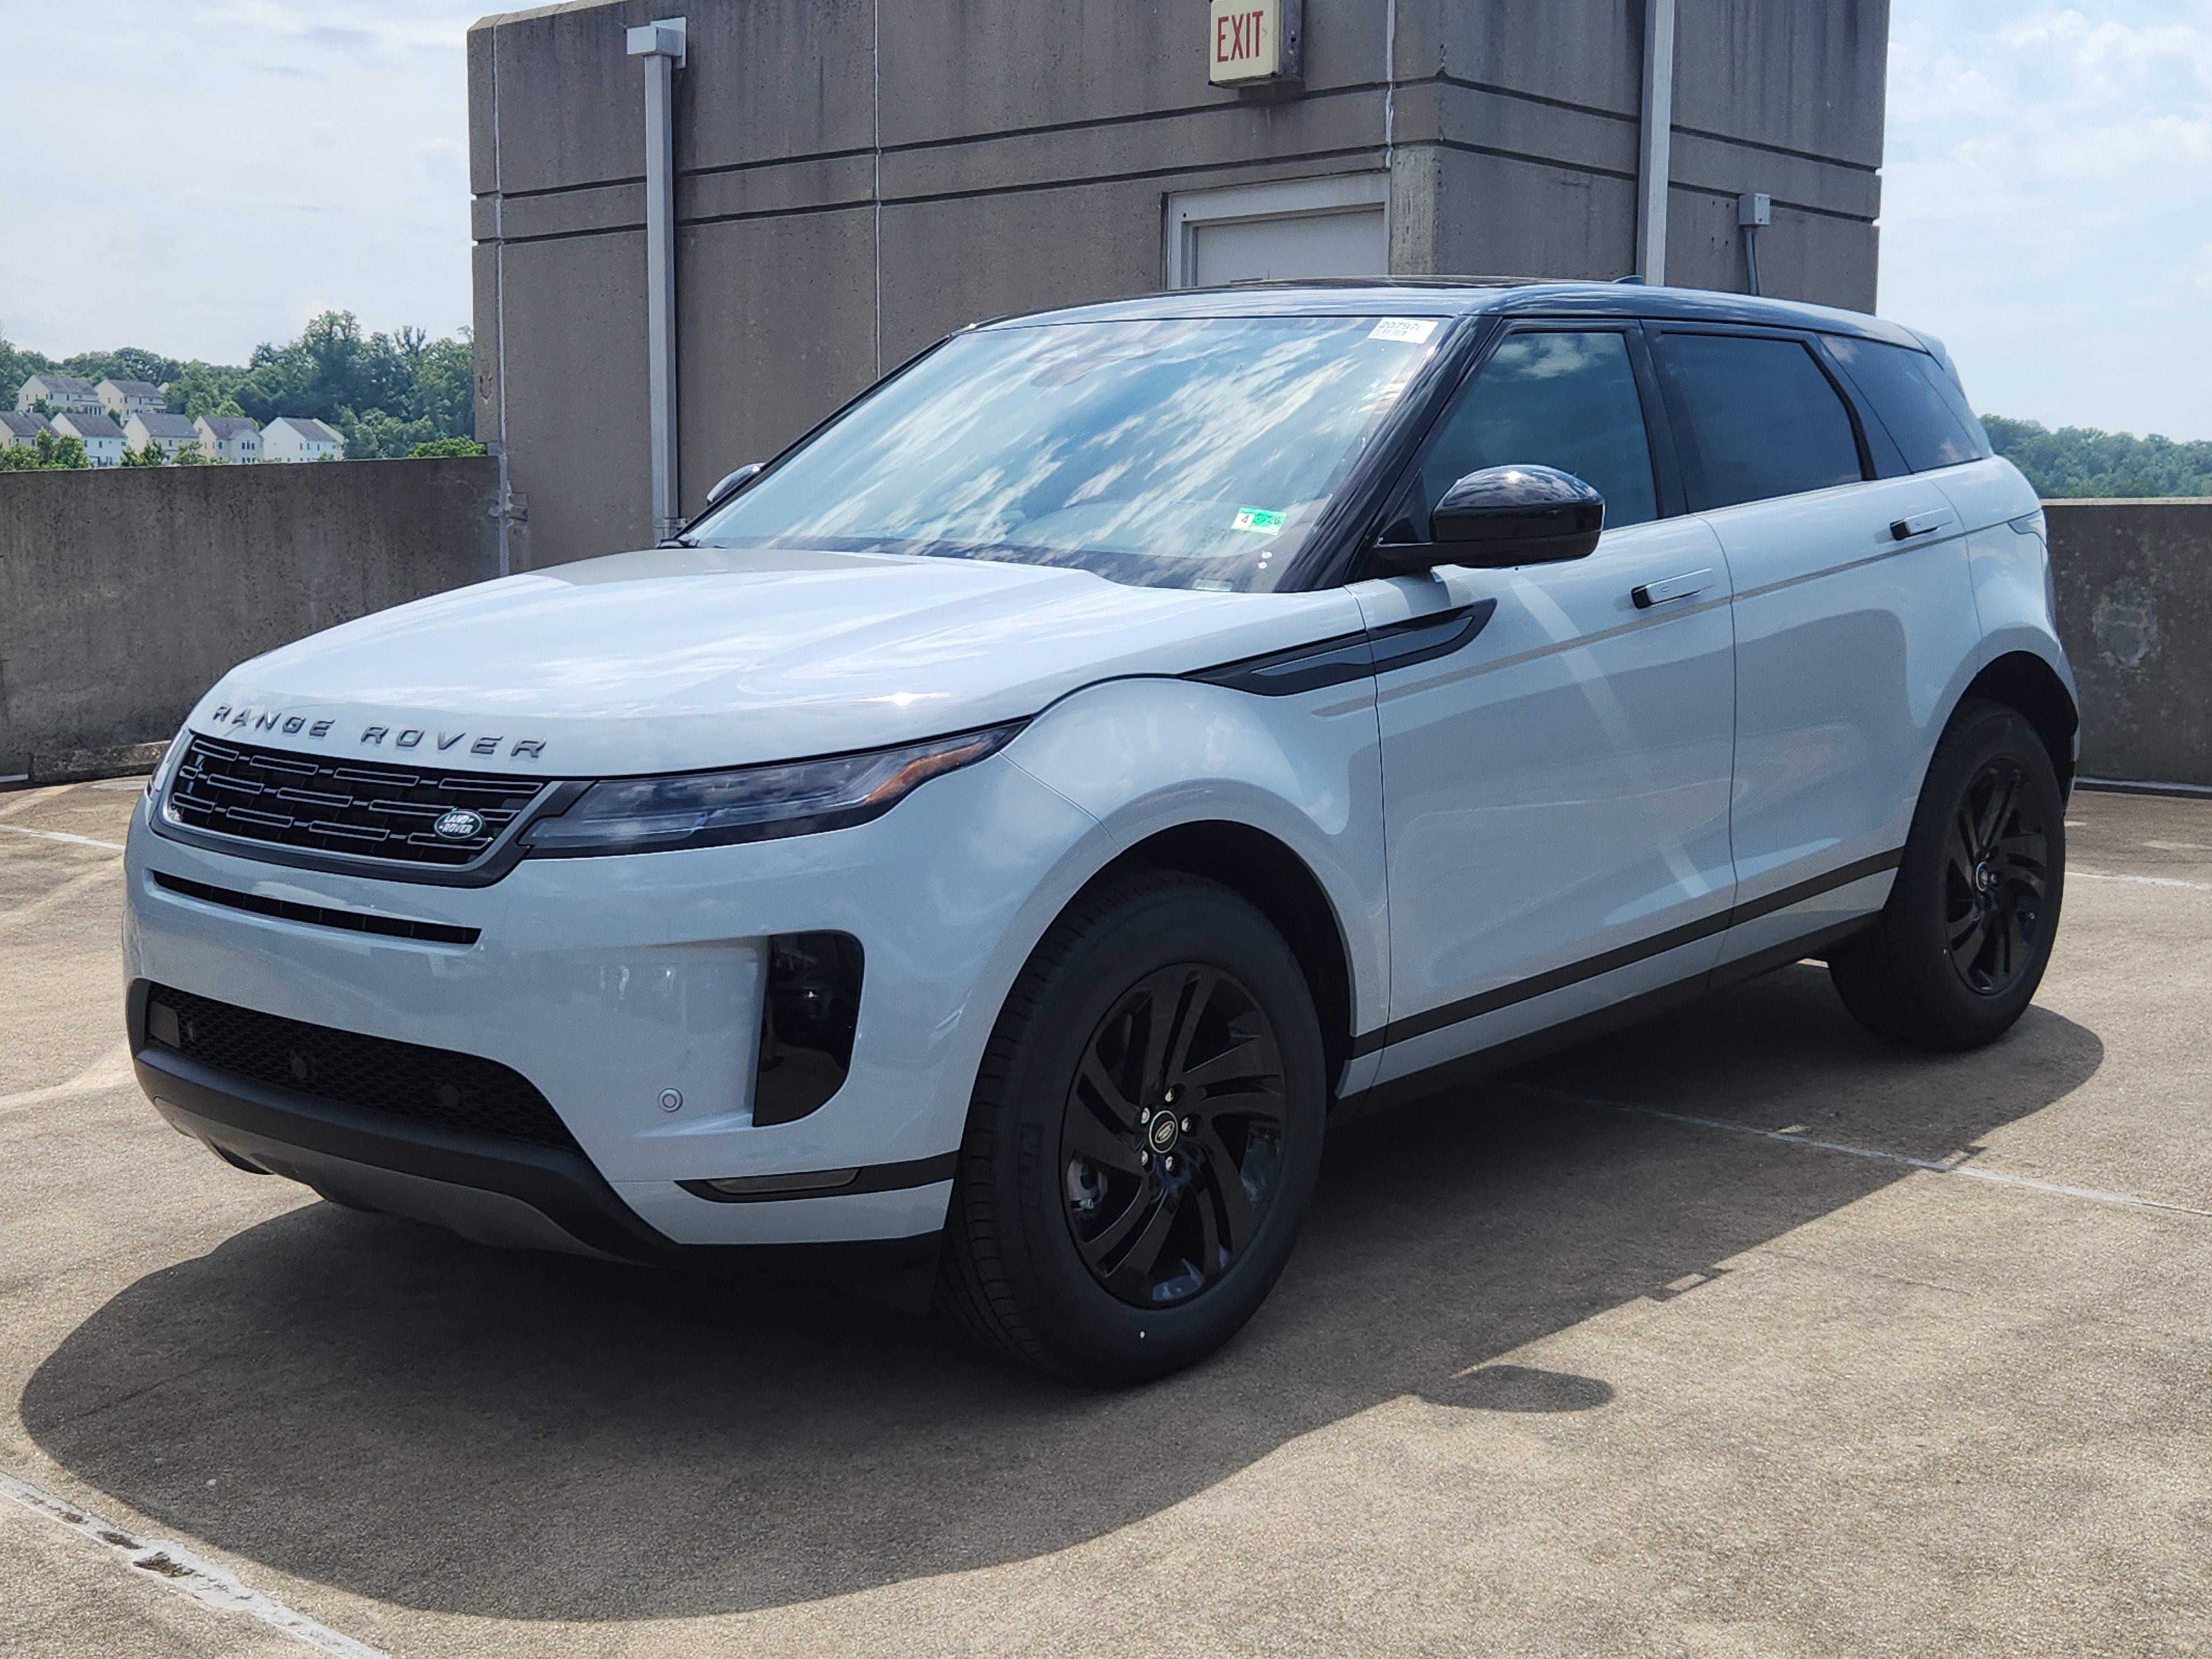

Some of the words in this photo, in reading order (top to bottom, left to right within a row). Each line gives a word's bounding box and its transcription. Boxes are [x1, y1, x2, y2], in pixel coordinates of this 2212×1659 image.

[1217, 11, 1264, 62] EXIT
[212, 705, 335, 737] RANGE
[361, 725, 546, 758] ROVER
[442, 823, 473, 834] ROVER
[443, 814, 470, 824] LAND
